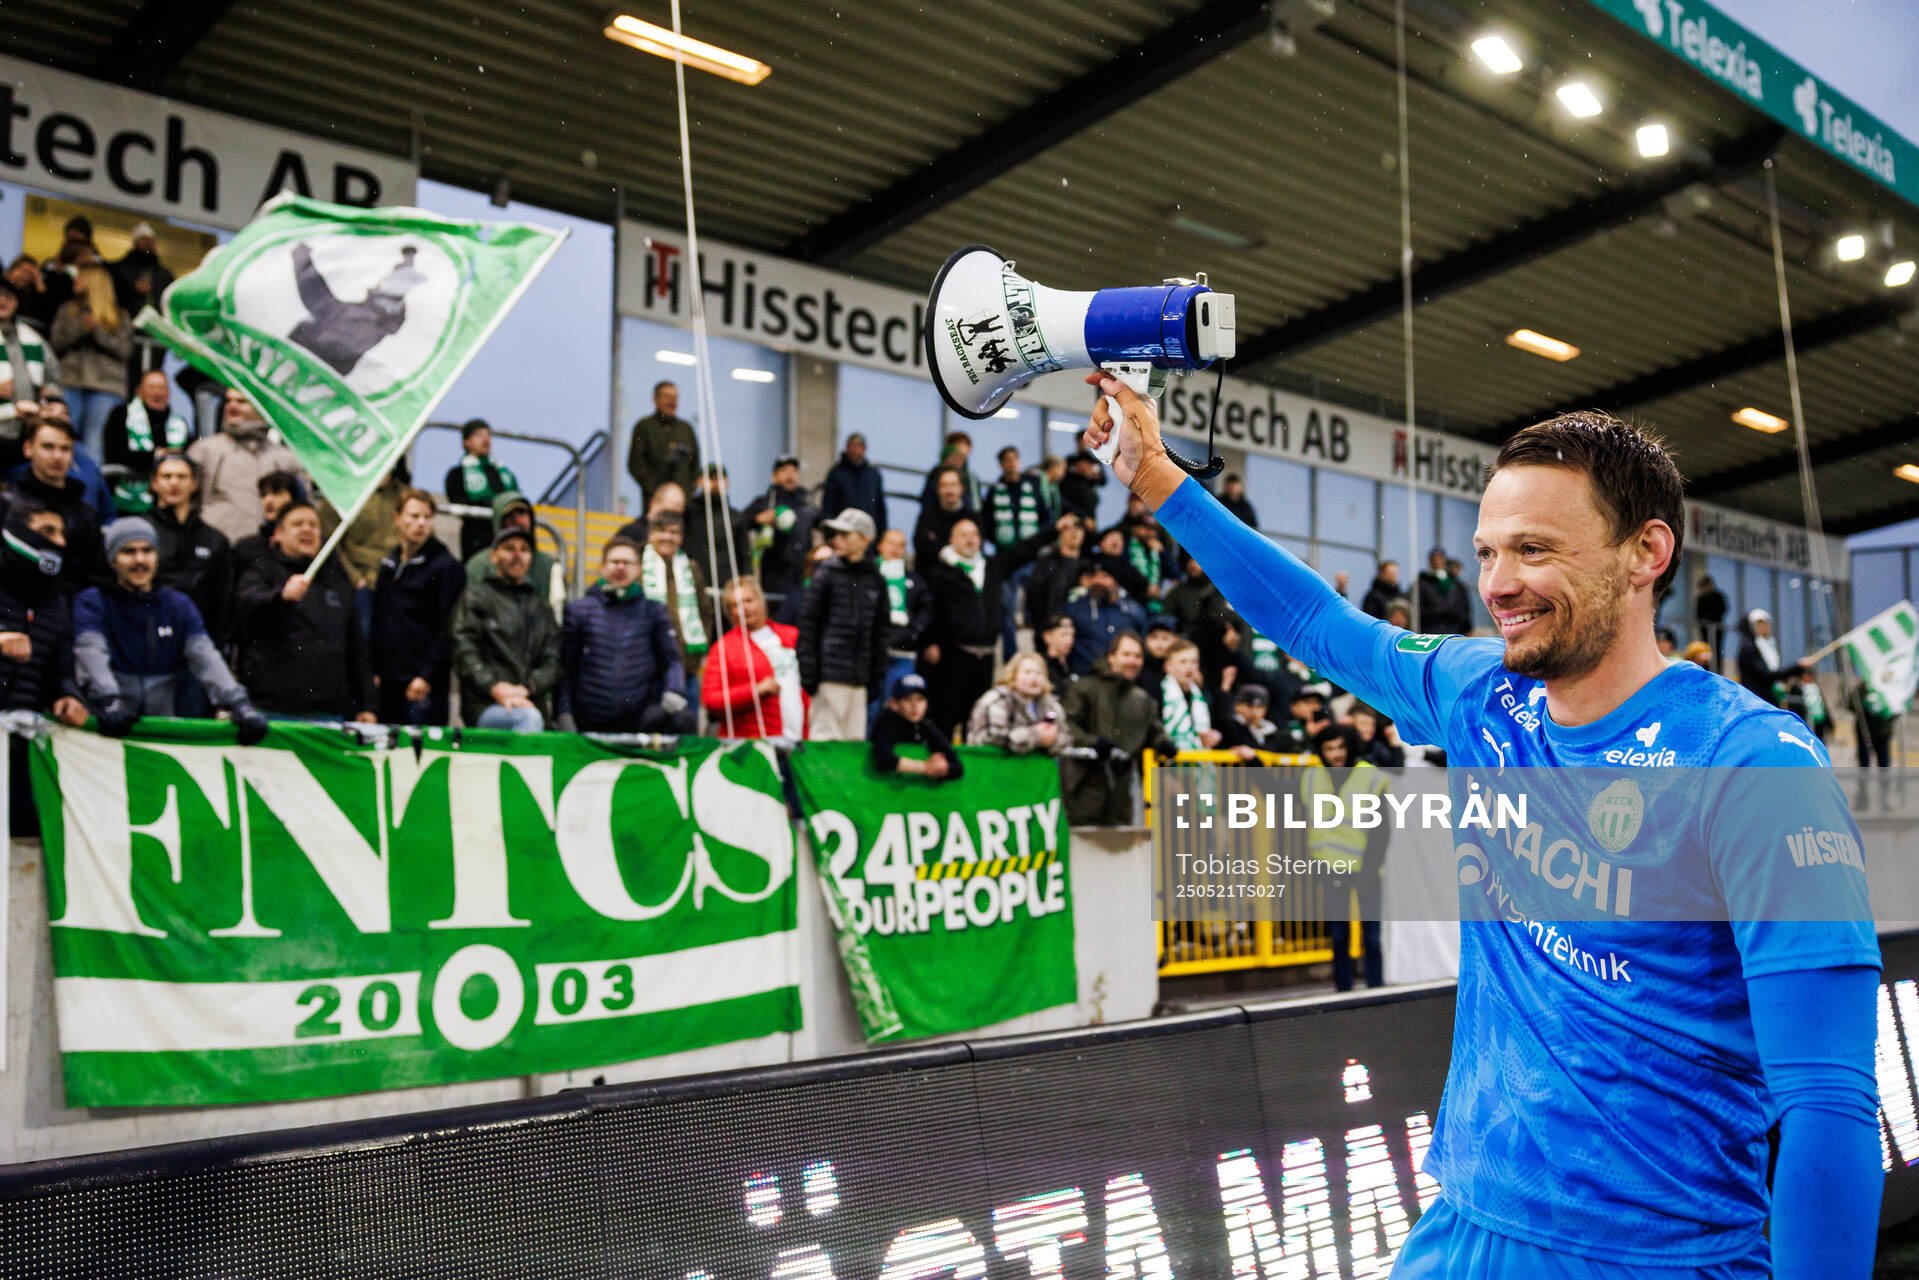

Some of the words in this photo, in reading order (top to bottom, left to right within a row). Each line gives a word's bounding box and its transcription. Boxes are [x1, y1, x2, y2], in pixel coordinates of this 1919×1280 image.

[1665, 0, 1763, 100] Telexia
[1819, 99, 1897, 185] Telexia
[1158, 384, 1289, 449] isstech
[1303, 407, 1351, 463] AB
[1415, 435, 1486, 495] Hisst
[1494, 677, 1541, 734] Teleia
[1603, 747, 1676, 768] elexia
[49, 729, 796, 939] FNTCS
[907, 798, 1061, 867] PARTY
[916, 861, 1066, 932] PEOPLE
